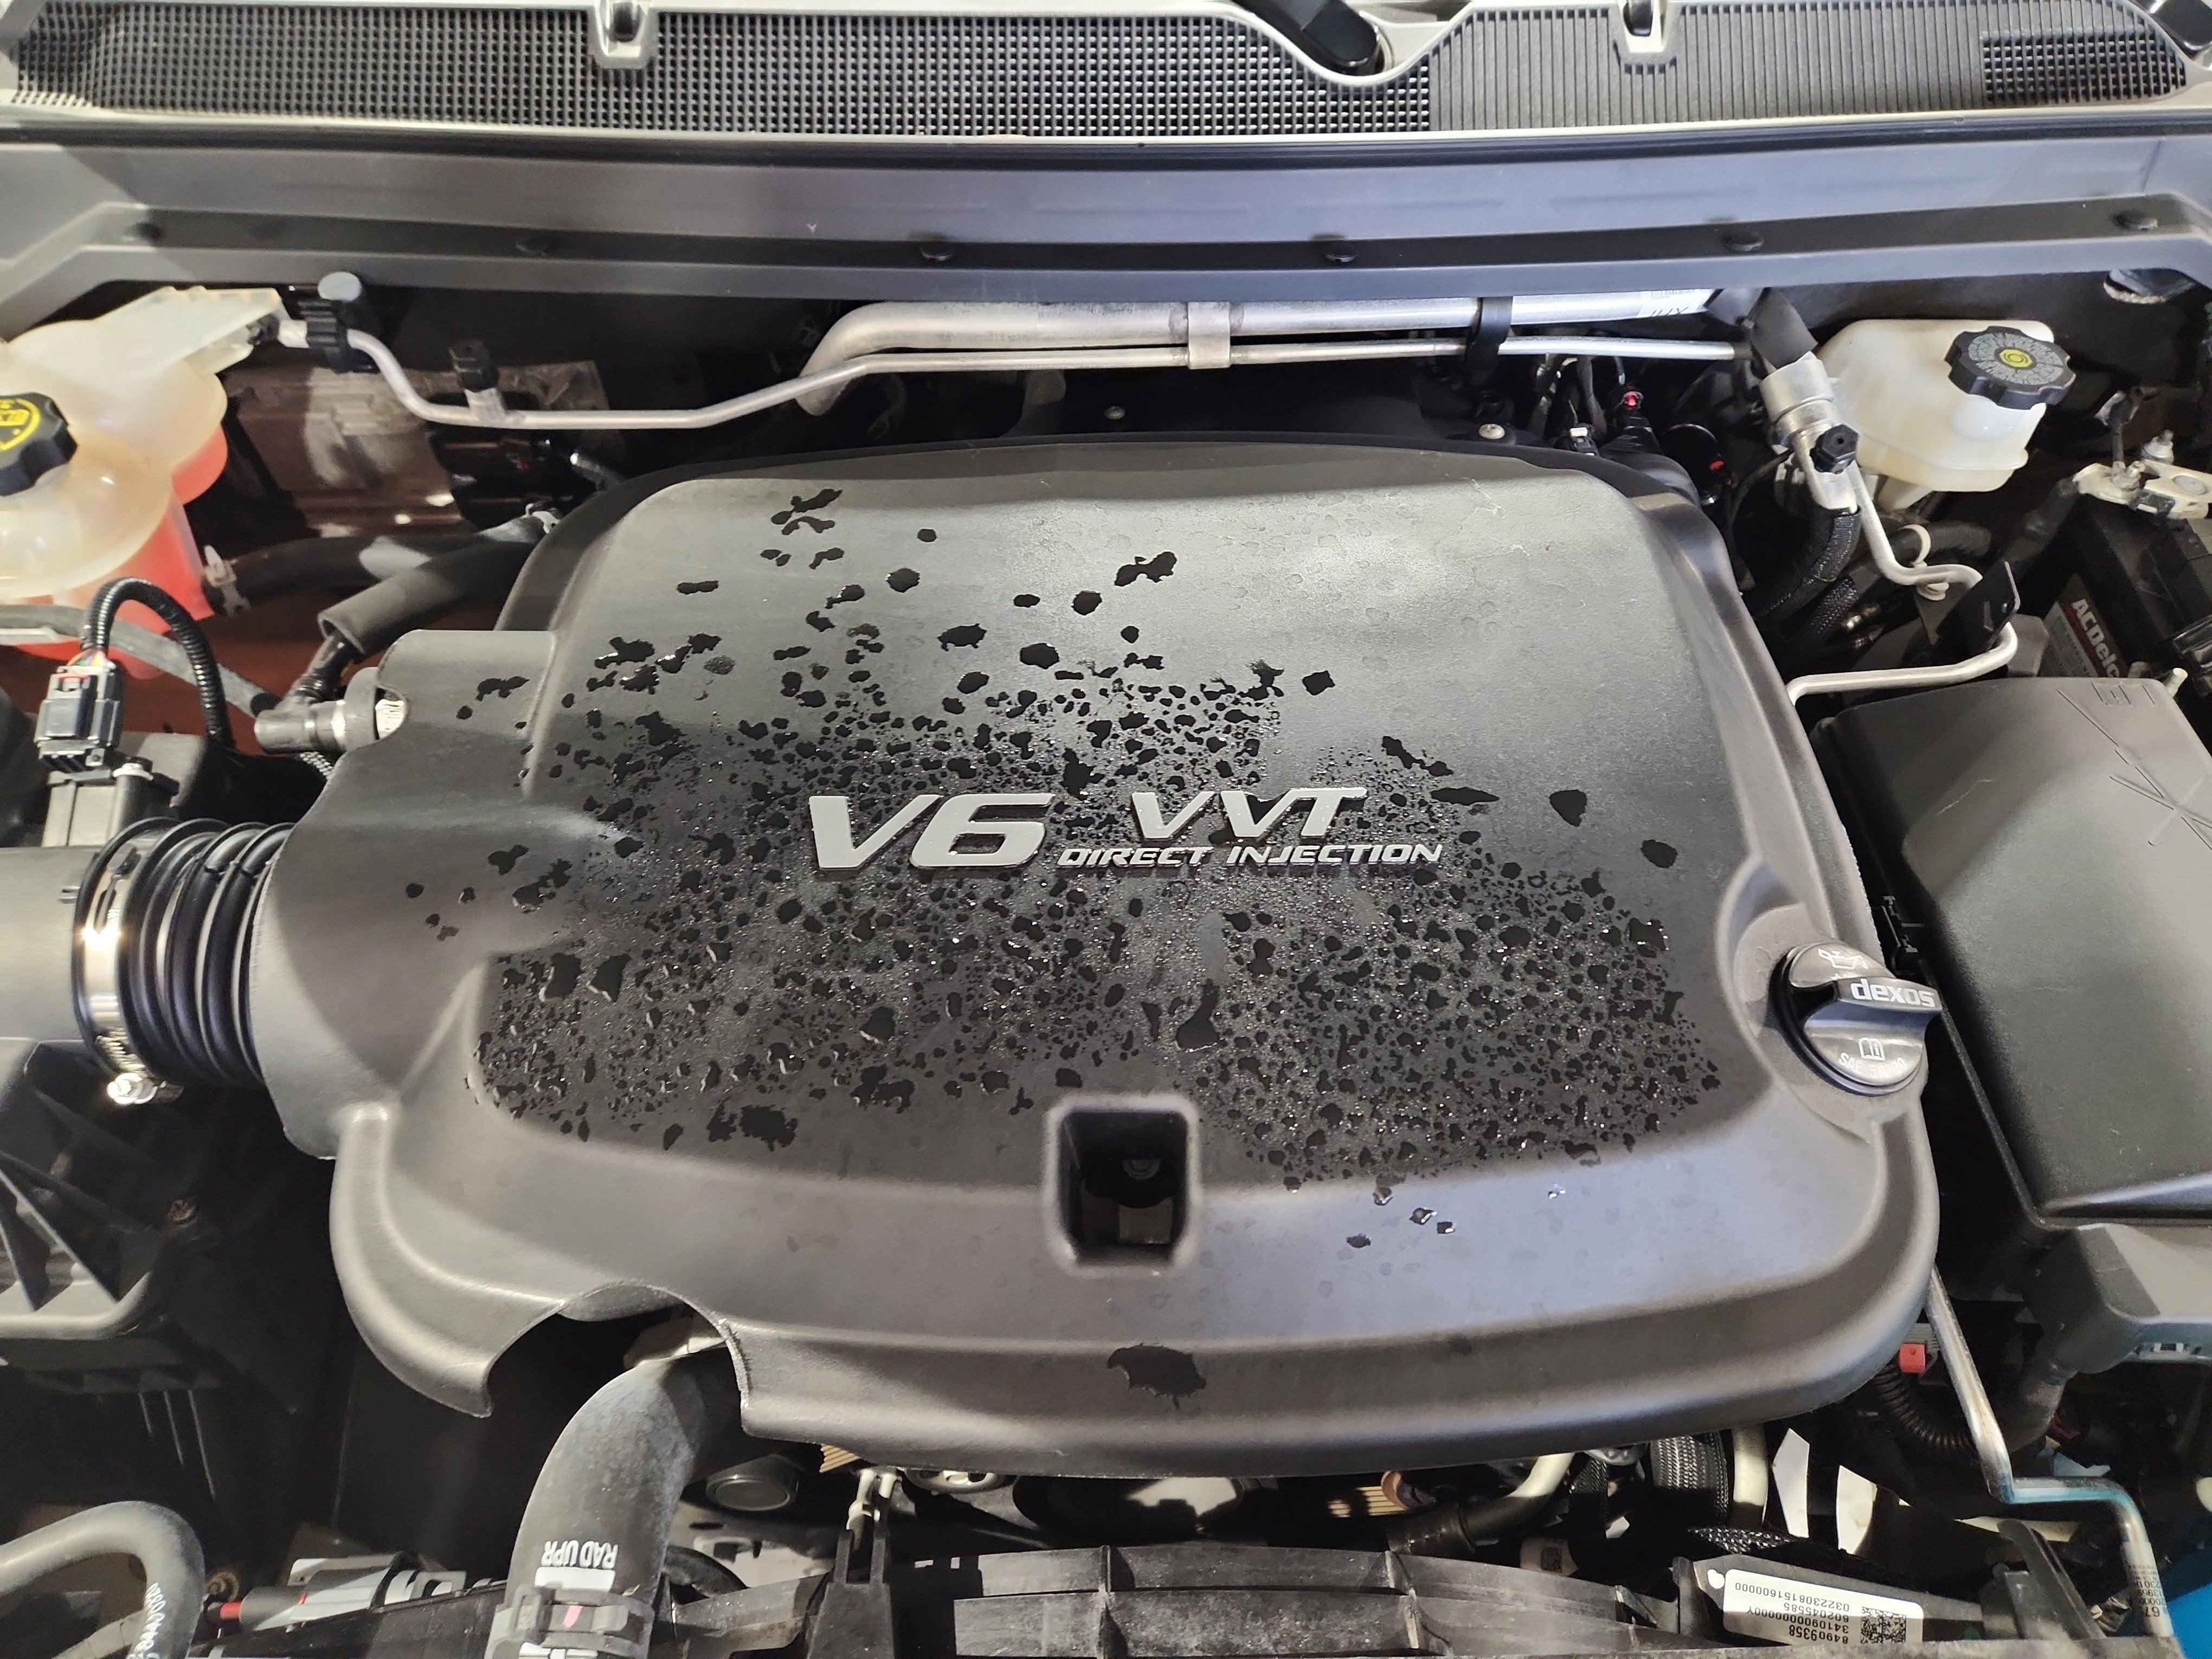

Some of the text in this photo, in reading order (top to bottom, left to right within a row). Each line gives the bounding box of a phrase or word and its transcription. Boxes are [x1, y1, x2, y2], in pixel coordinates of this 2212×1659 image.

[2073, 599, 2119, 677] ACDelc
[1131, 787, 1368, 839] VVT
[809, 794, 1054, 869] V6
[1057, 844, 1443, 867] DIRECT INJECTION
[1850, 979, 1936, 1007] dexos
[541, 1540, 619, 1570] RAD UPR
[1735, 1582, 1850, 1612] 0322308151600000
[1747, 1606, 1849, 1634] 3410900000000Y
[1784, 1602, 1849, 1623] 602045585
[1789, 1624, 1849, 1644] 84909358
